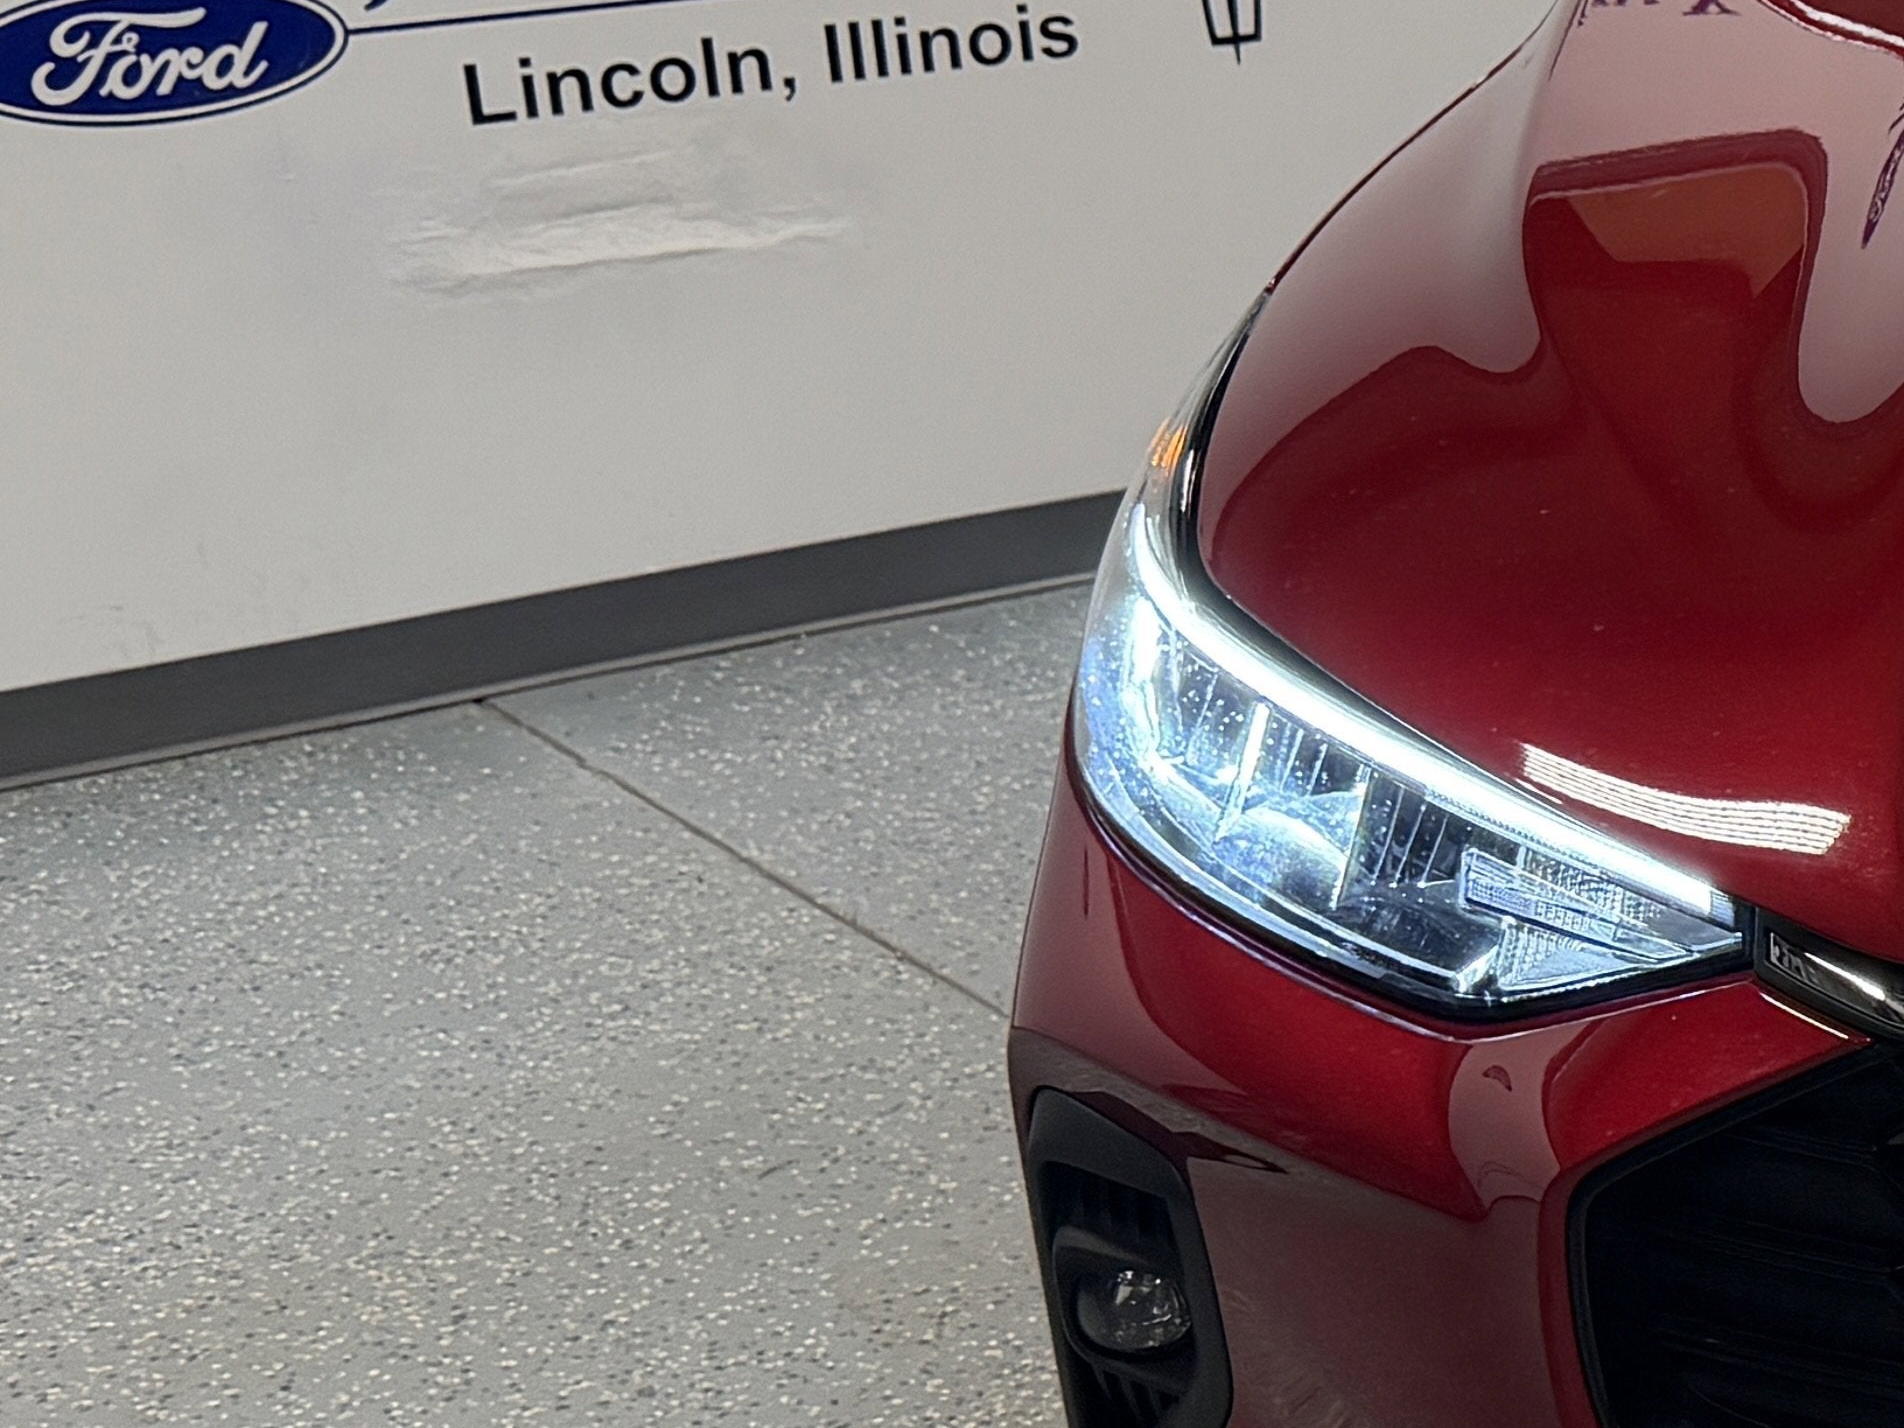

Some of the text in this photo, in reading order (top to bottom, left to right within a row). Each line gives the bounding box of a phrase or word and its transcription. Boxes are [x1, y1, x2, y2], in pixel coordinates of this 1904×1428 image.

[31, 7, 268, 106] Ford
[463, 3, 1078, 126] Lincoln, Illinois
